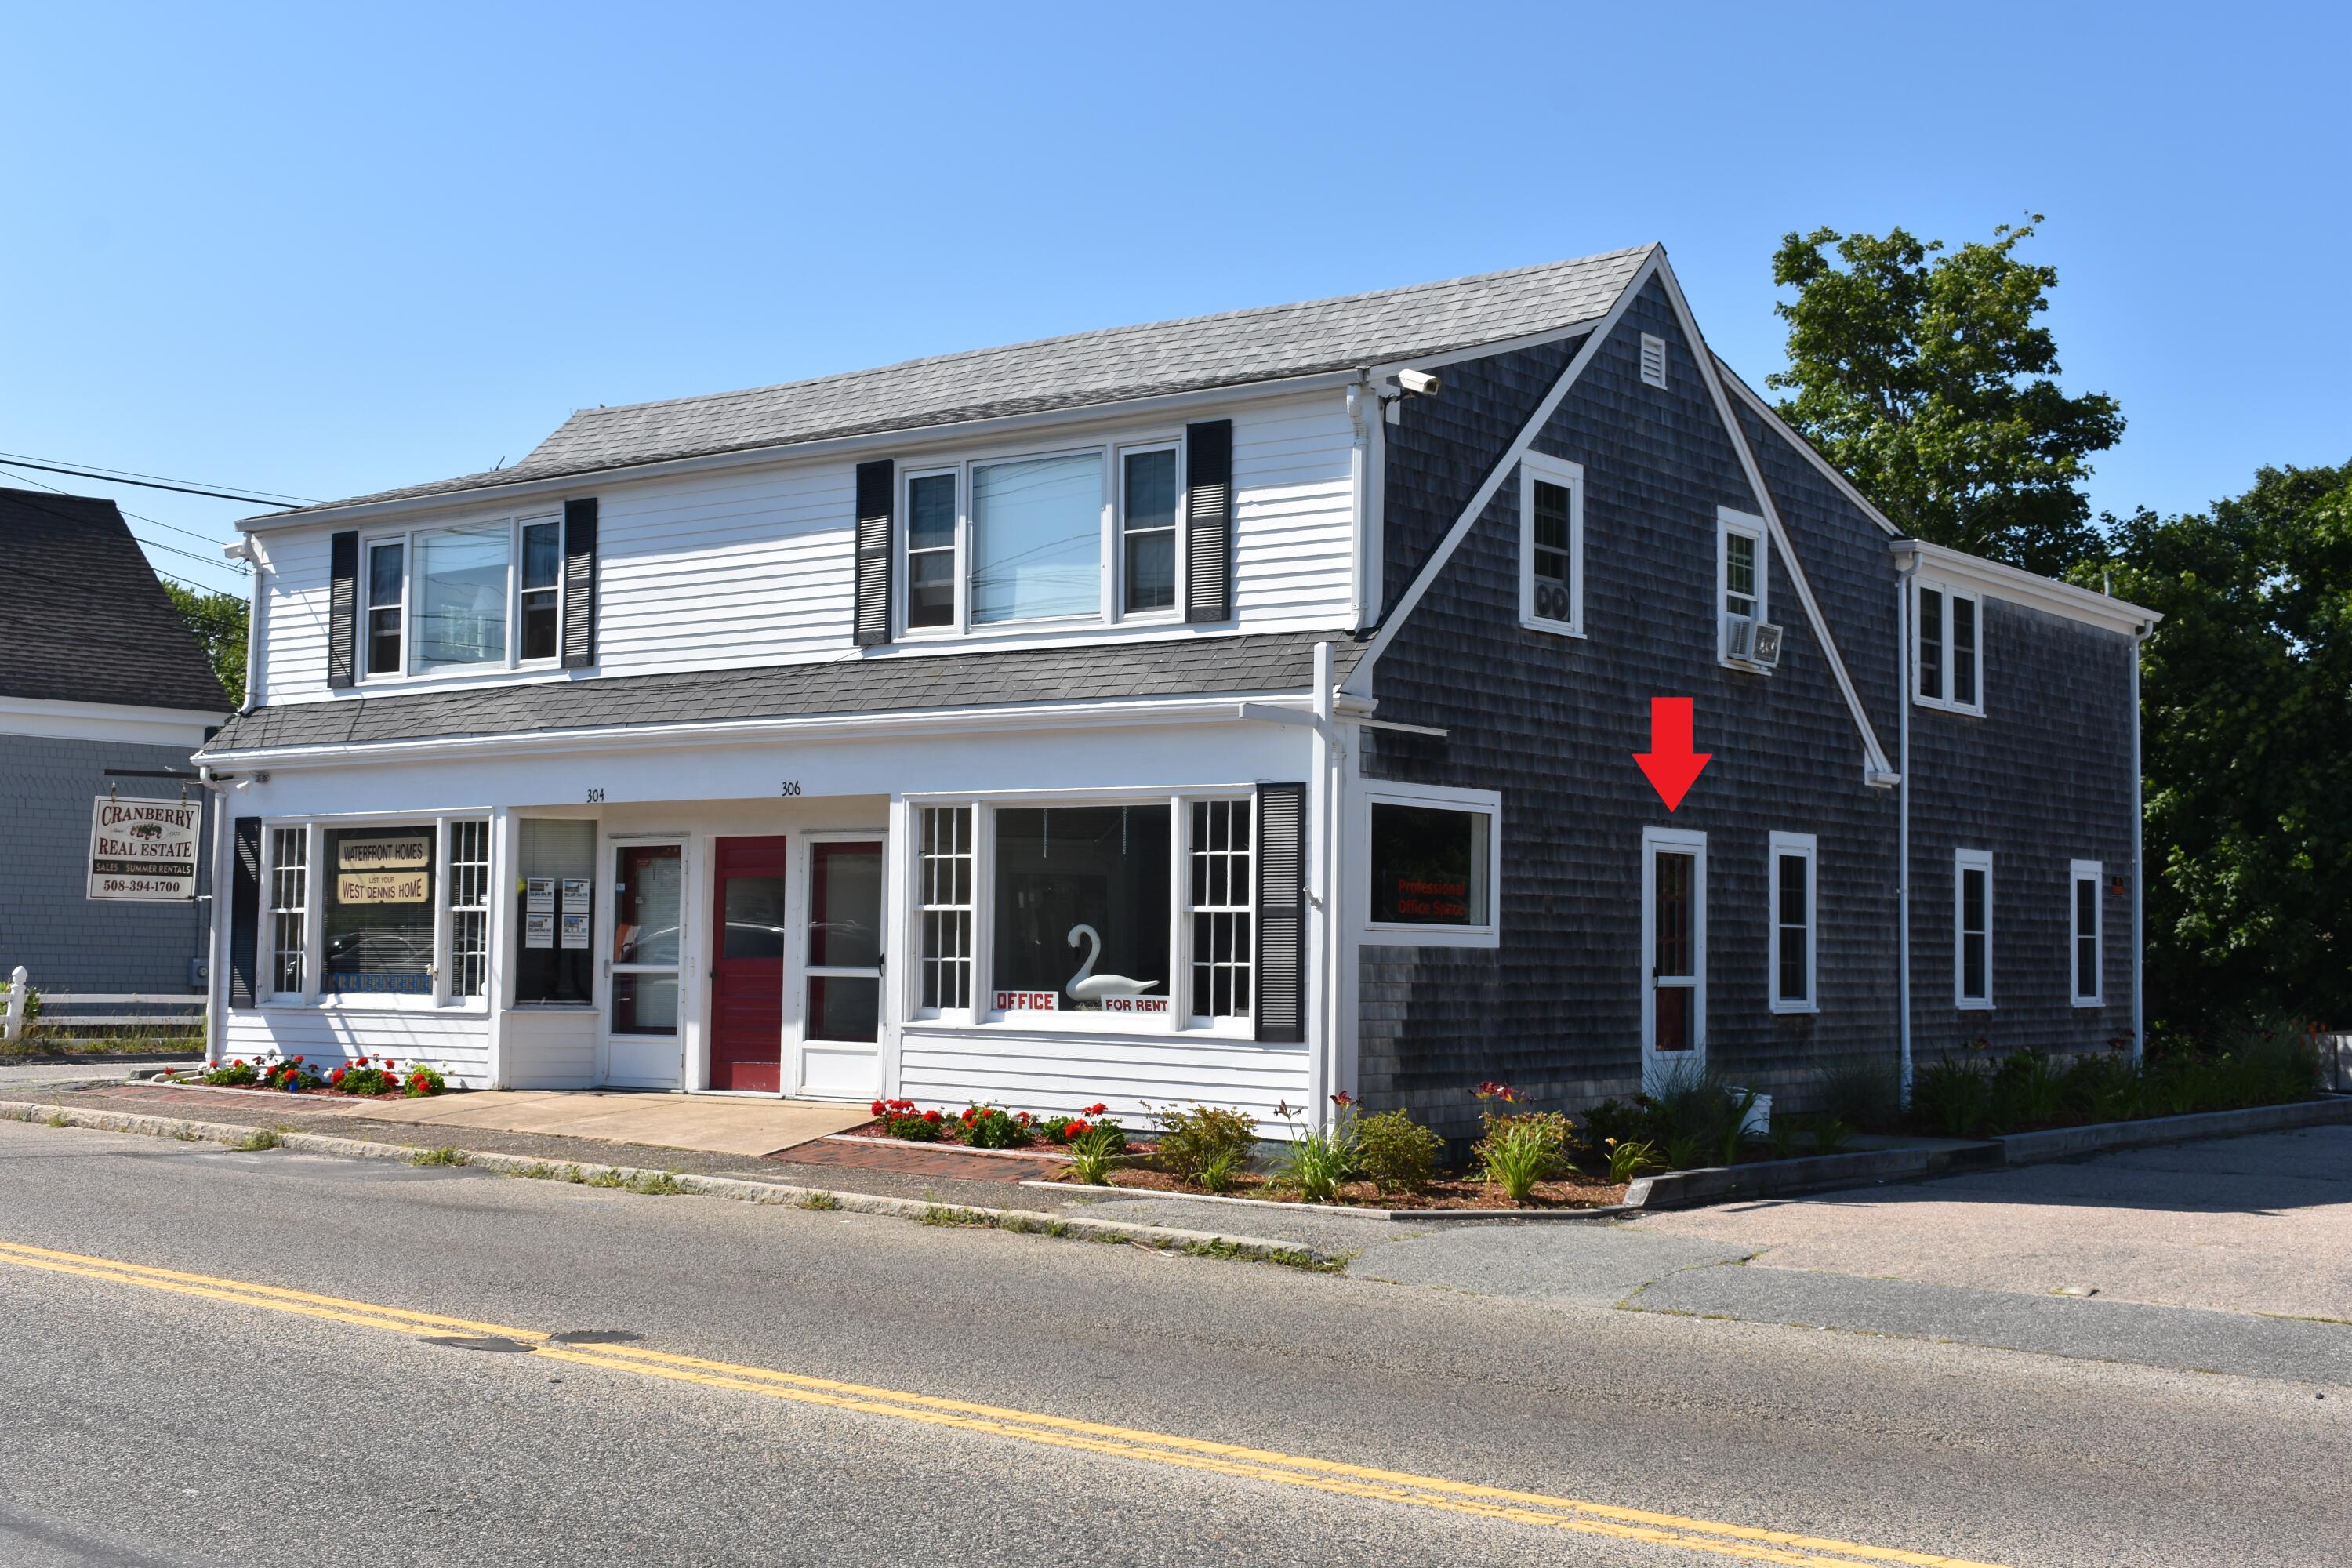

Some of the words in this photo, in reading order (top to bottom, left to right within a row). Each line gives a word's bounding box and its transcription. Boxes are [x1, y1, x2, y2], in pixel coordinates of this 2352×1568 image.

[586, 788, 604, 803] 304
[782, 780, 801, 797] 306
[102, 806, 194, 829] CRANBERRY
[98, 837, 137, 856] REAL
[140, 841, 192, 858] ESTATE
[344, 844, 393, 862] WATERFRONT
[395, 843, 423, 860] HOMES
[96, 863, 118, 872] SALES
[125, 864, 157, 873] SUMMER
[158, 865, 191, 874] RENTALS
[103, 880, 180, 892] 508-394-1700
[343, 880, 365, 898] WEST
[367, 886, 395, 898] DENNIS
[398, 878, 422, 898] HOME
[1398, 878, 1465, 895] Professional
[1399, 900, 1430, 915] Office
[1434, 901, 1465, 916] Space
[996, 993, 1054, 1010] OFFICE
[1106, 999, 1131, 1011] FOR
[1137, 1000, 1167, 1012] RENT
